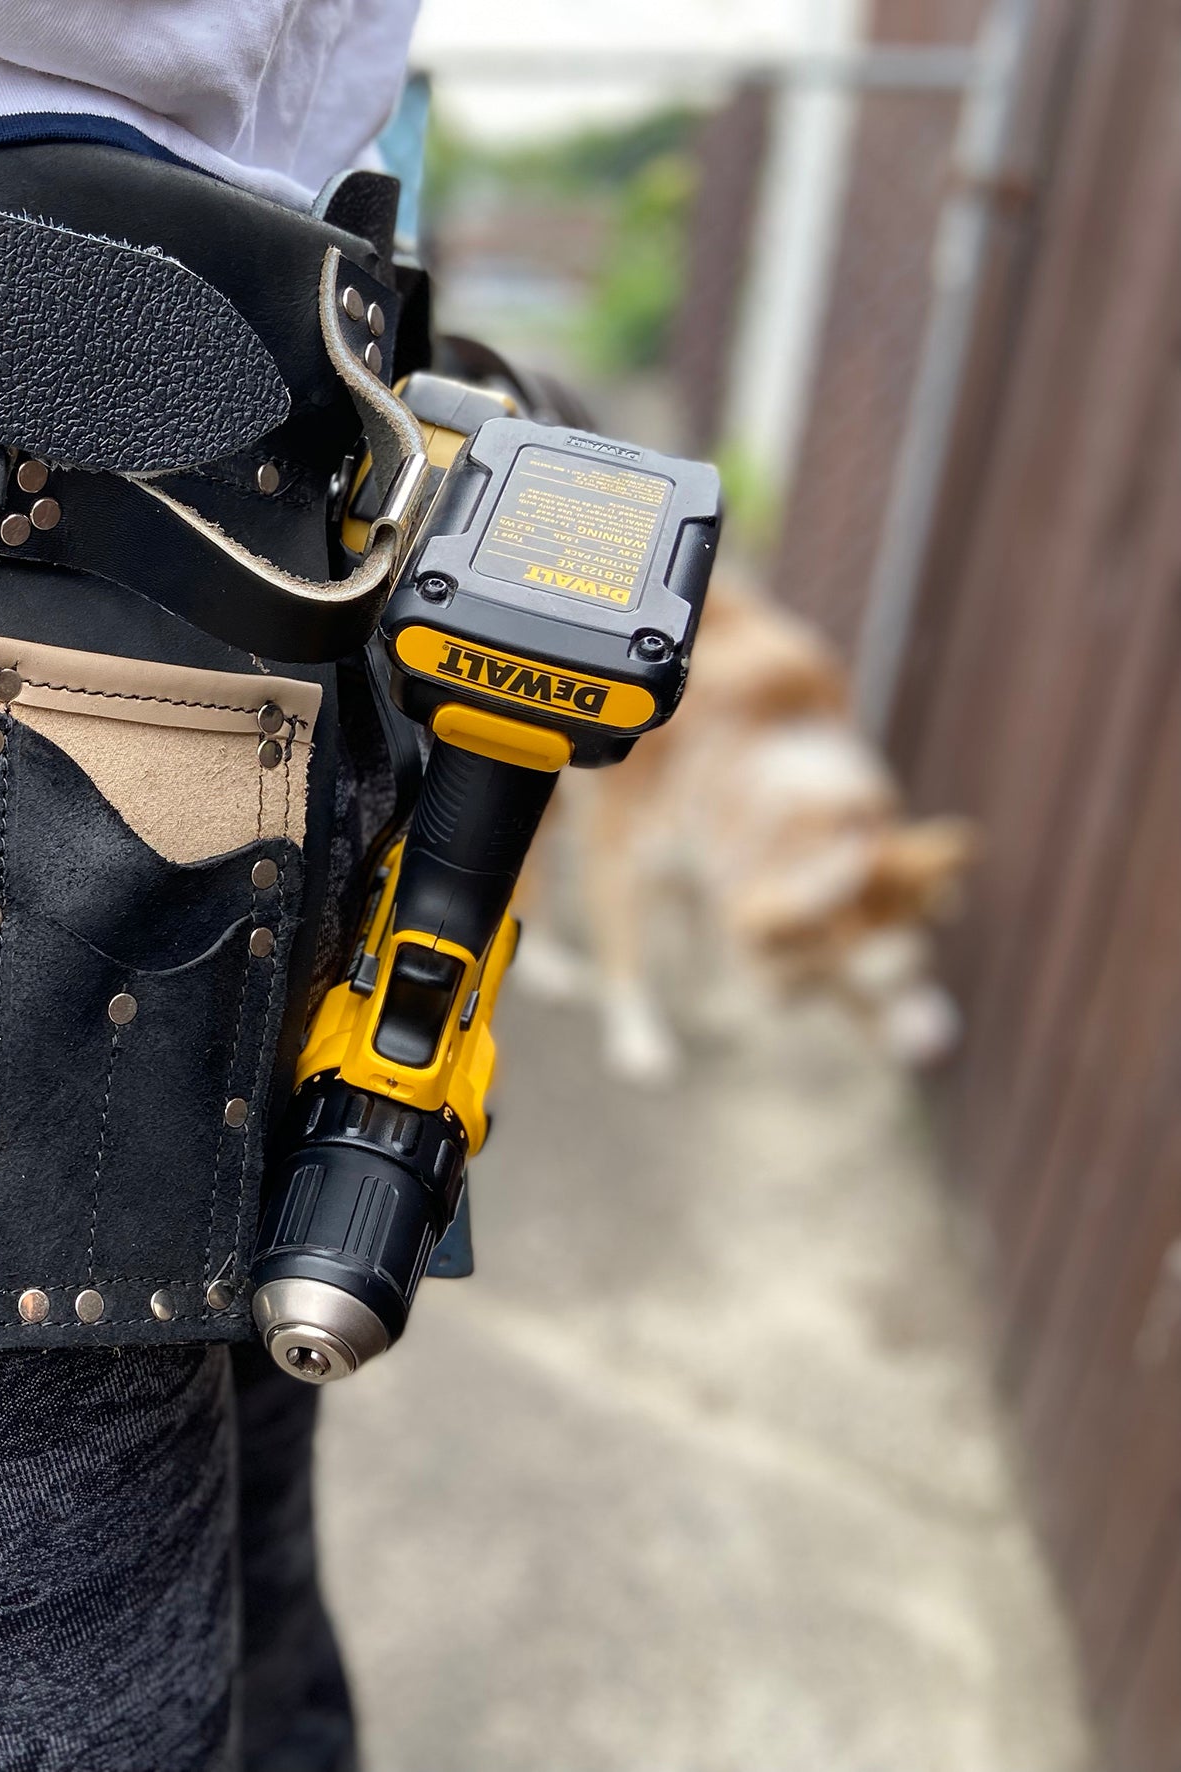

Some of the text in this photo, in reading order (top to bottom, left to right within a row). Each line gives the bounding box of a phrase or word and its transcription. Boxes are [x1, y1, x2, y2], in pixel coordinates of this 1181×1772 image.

[499, 530, 524, 542] Type
[572, 524, 648, 549] WARNING:
[554, 557, 635, 584] DCB123-XE
[562, 547, 639, 572] BATTERY PACK
